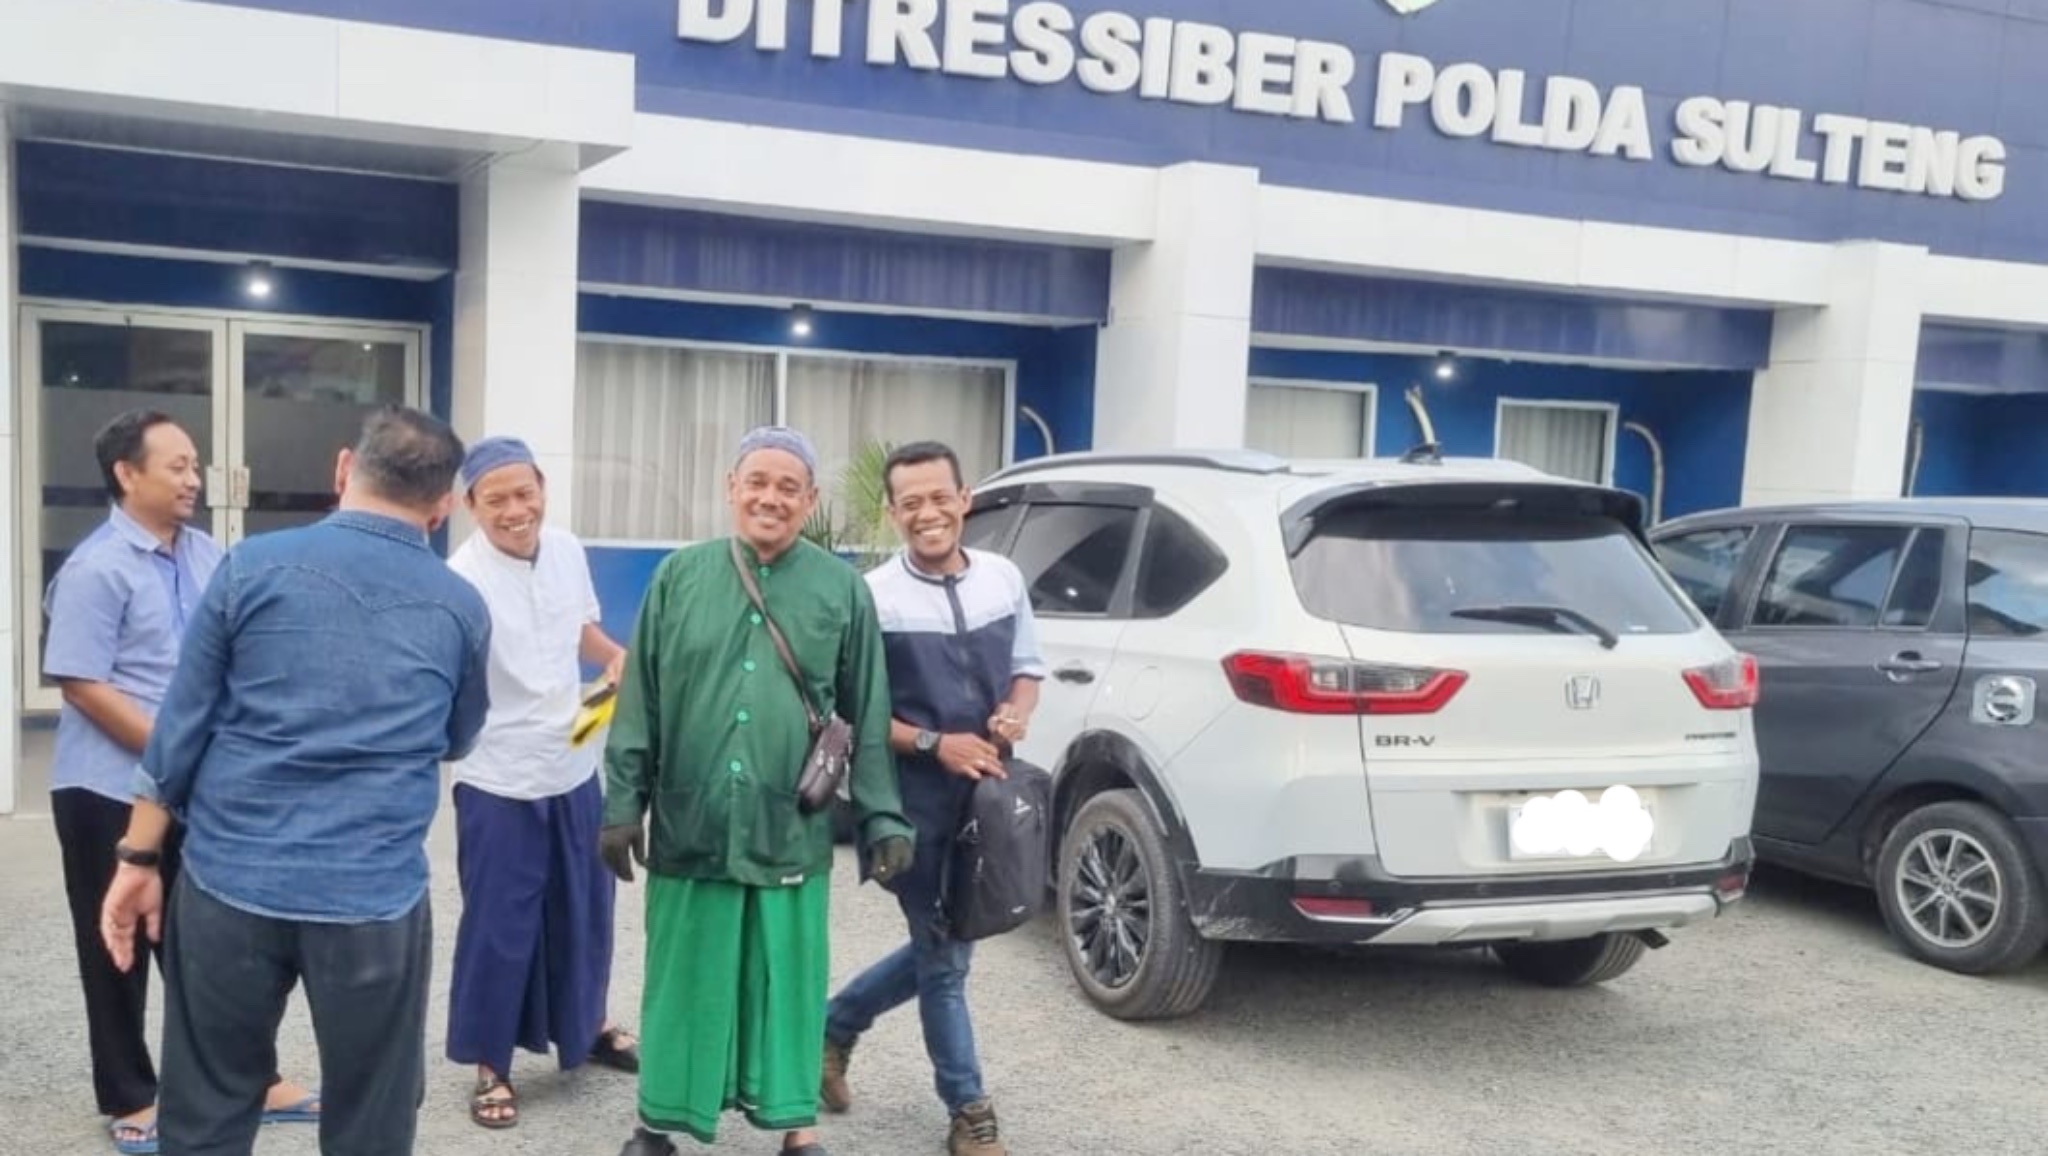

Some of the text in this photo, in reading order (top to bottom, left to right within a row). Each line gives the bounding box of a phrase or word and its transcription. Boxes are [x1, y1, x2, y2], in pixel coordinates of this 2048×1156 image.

[1374, 51, 1654, 160] POLDA
[1672, 95, 2009, 200] SULTENG
[1375, 735, 1436, 747] BR-V
